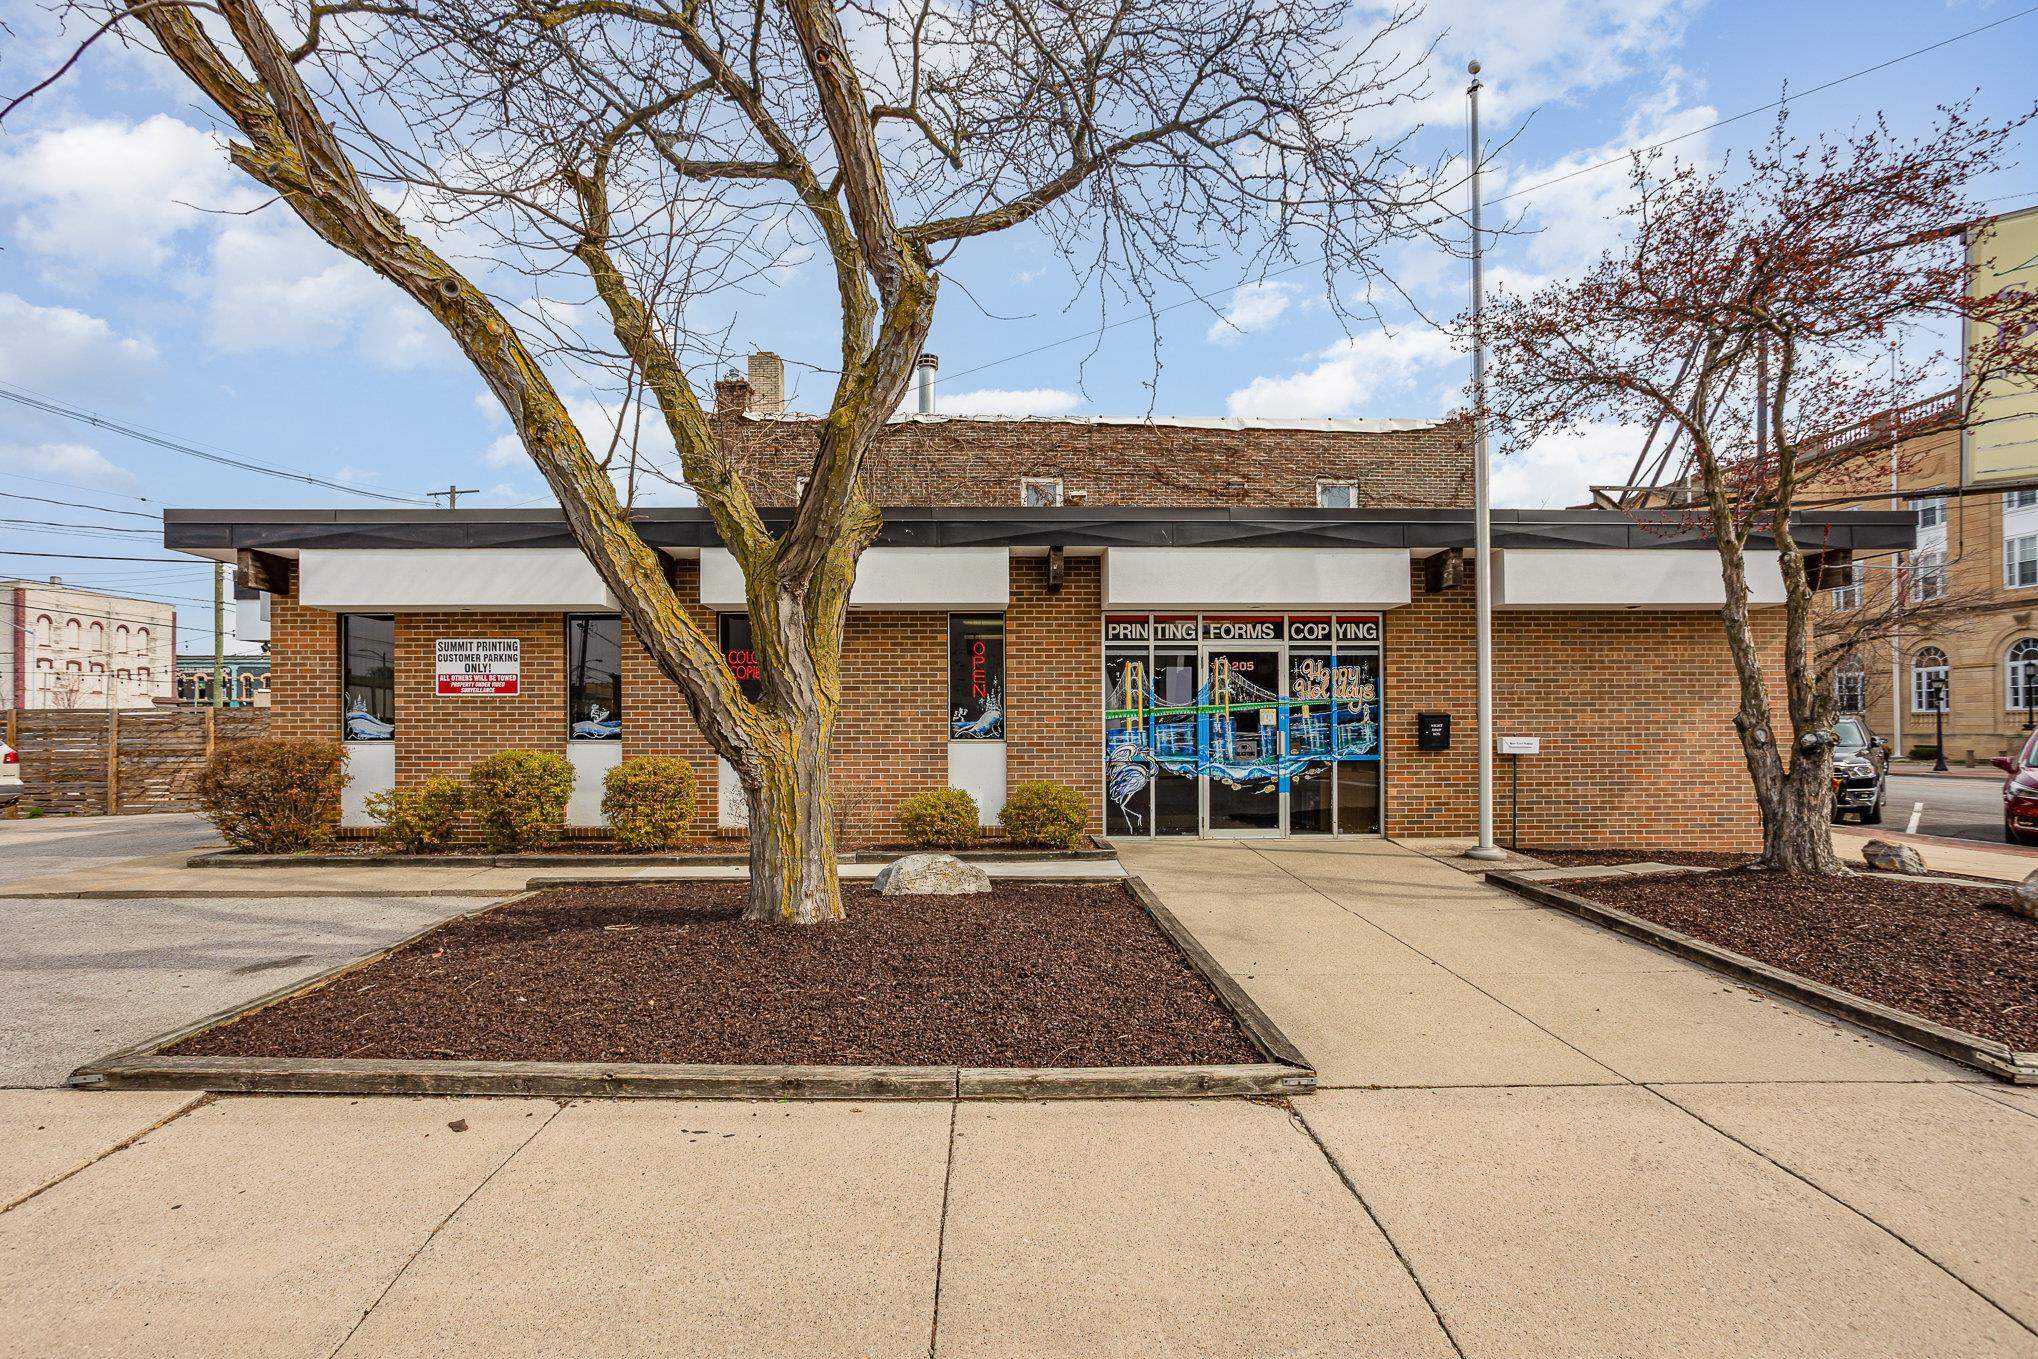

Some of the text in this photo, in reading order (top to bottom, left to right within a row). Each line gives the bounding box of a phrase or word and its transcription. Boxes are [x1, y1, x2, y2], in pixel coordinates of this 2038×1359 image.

[1108, 623, 1377, 639] PRINTING FORMS COPYING
[437, 641, 518, 652] SUMMIT PRINTING
[437, 653, 518, 662] CUSTOMER PARKING
[464, 663, 492, 673] ONLY!
[973, 641, 986, 698] OPEN
[1231, 661, 1255, 672] 205
